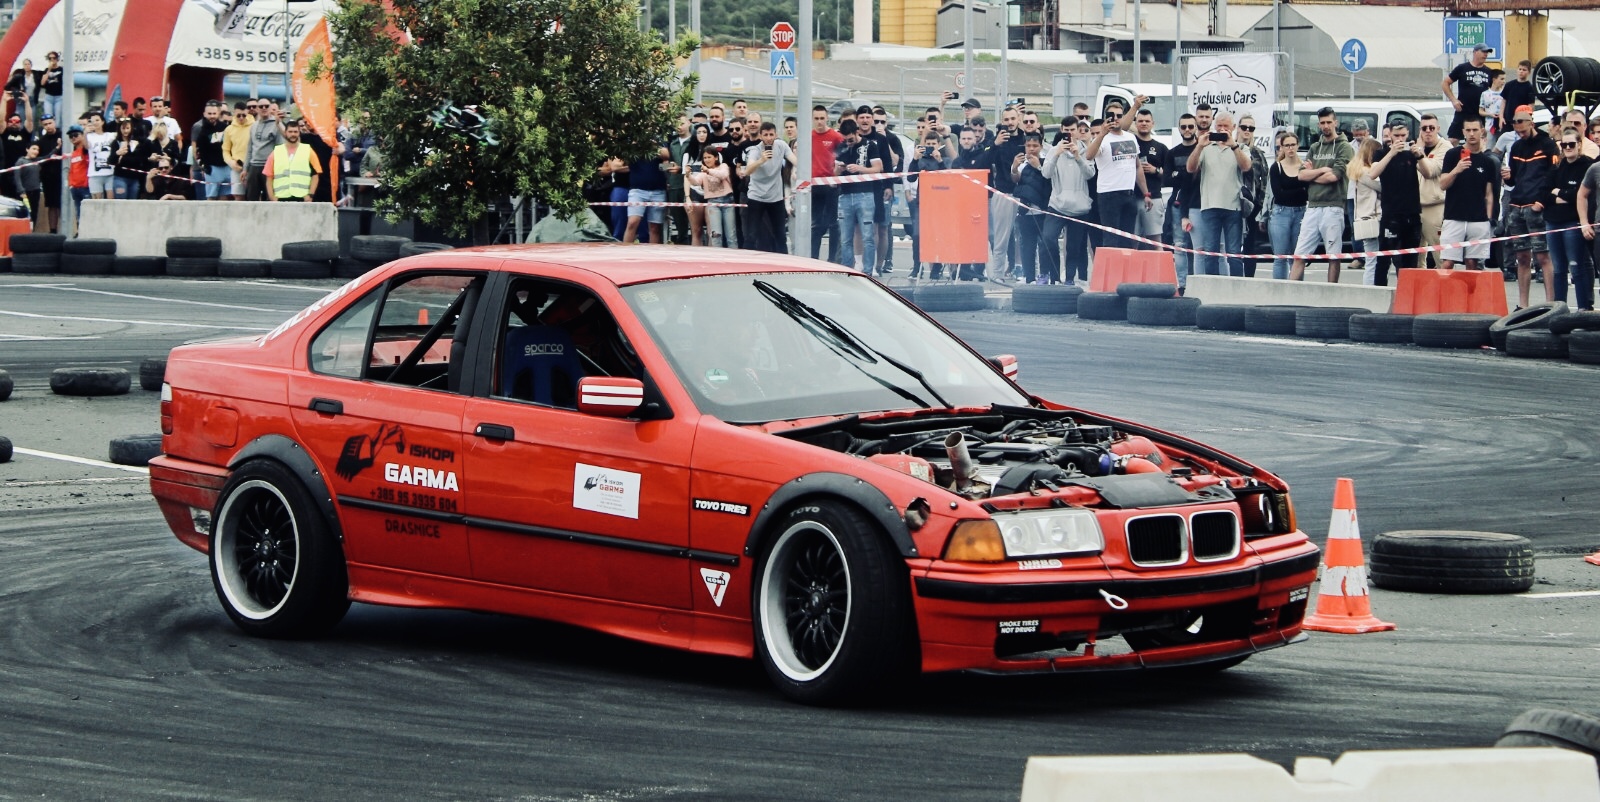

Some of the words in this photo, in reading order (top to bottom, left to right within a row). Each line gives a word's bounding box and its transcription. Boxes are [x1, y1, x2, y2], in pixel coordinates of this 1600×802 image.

[1459, 23, 1483, 35] Zagreb
[772, 30, 793, 42] STOP
[1459, 35, 1475, 46] Split
[195, 47, 231, 61] +385
[235, 50, 254, 62] 95
[258, 51, 287, 63] 506
[1193, 91, 1232, 105] Exclusive
[1233, 90, 1257, 105] Cars
[524, 343, 564, 356] sparco
[409, 444, 455, 463] ISKOPI
[384, 462, 459, 492] GARMA
[695, 499, 720, 512] TOYO
[720, 502, 748, 515] TIRES
[790, 506, 820, 517] TOYO
[999, 620, 1021, 628] SMOKE
